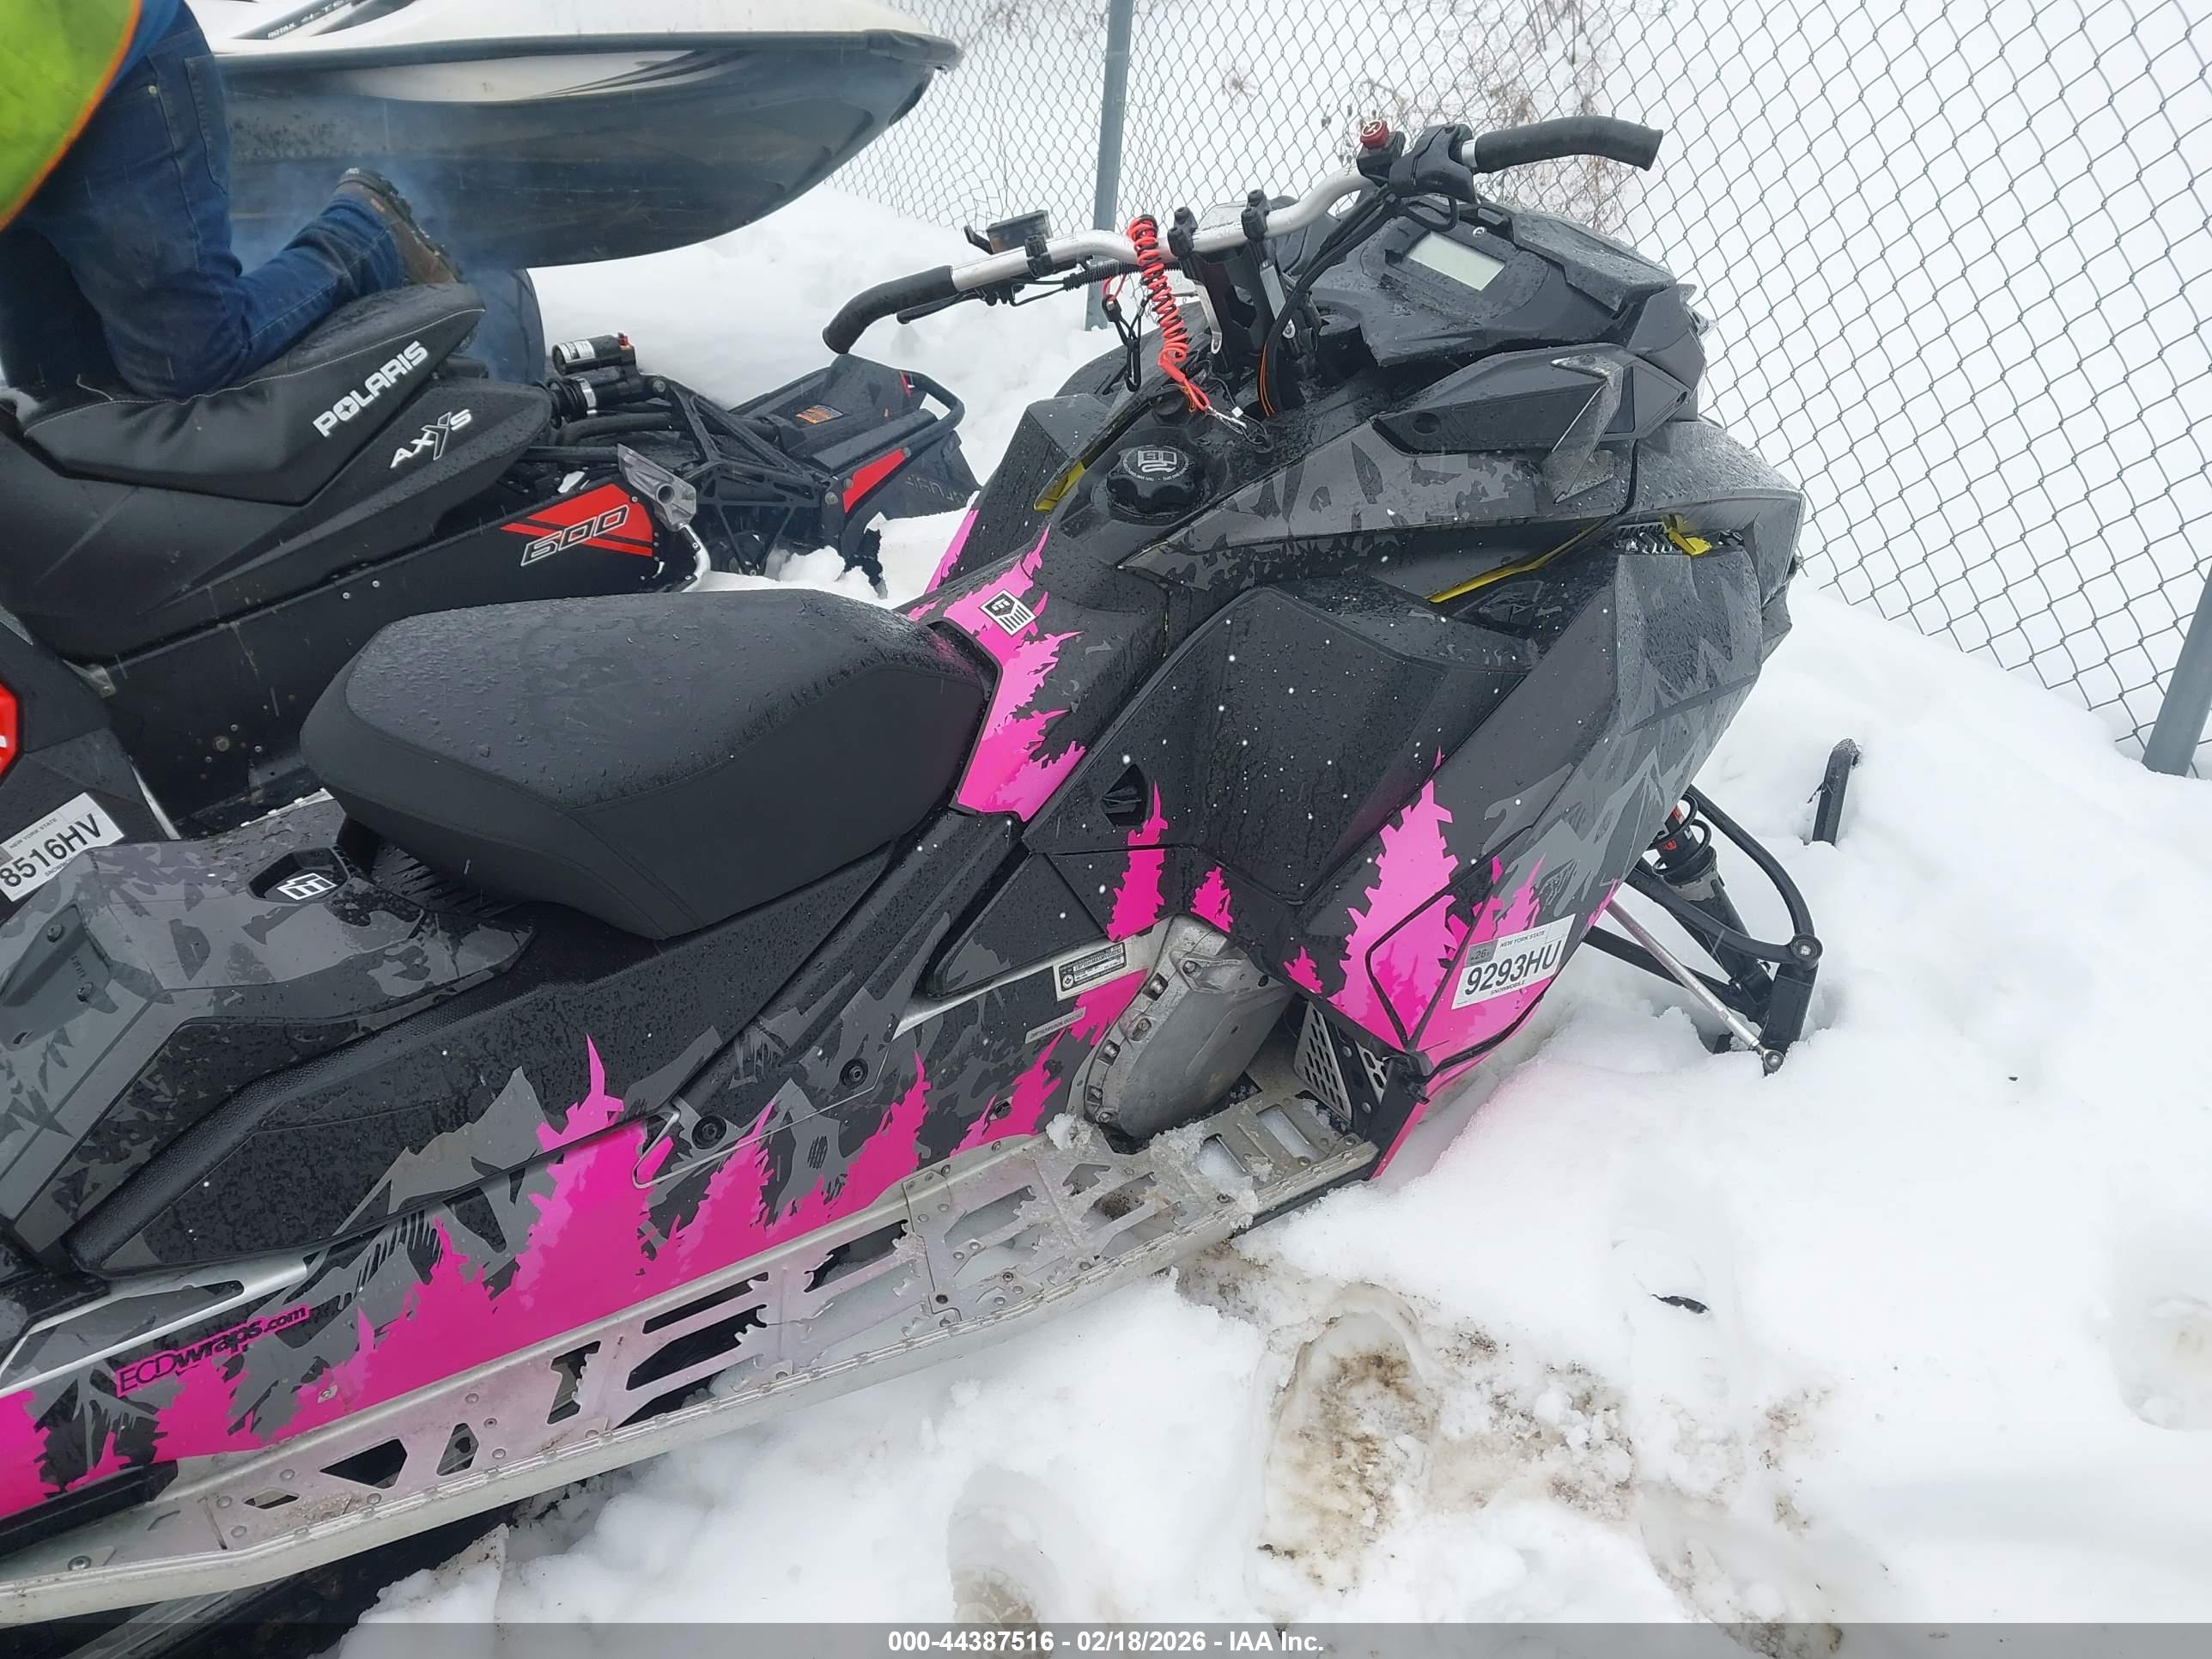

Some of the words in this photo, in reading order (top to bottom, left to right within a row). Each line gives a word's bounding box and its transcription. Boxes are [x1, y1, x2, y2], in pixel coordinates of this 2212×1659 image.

[313, 341, 428, 437] POLARIS
[391, 409, 471, 469] AXYS
[520, 504, 629, 567] 600
[0, 813, 101, 887] 8516HV
[9, 839, 22, 848] NEW
[23, 828, 39, 840] YORK
[40, 817, 57, 830] STATE
[1514, 935, 1528, 944] YORK
[1529, 930, 1545, 940] STATE
[1464, 939, 1563, 996] 9293HU
[1490, 980, 1526, 995] SNOWMOBILE
[119, 1306, 306, 1393] ECDwraps.com
